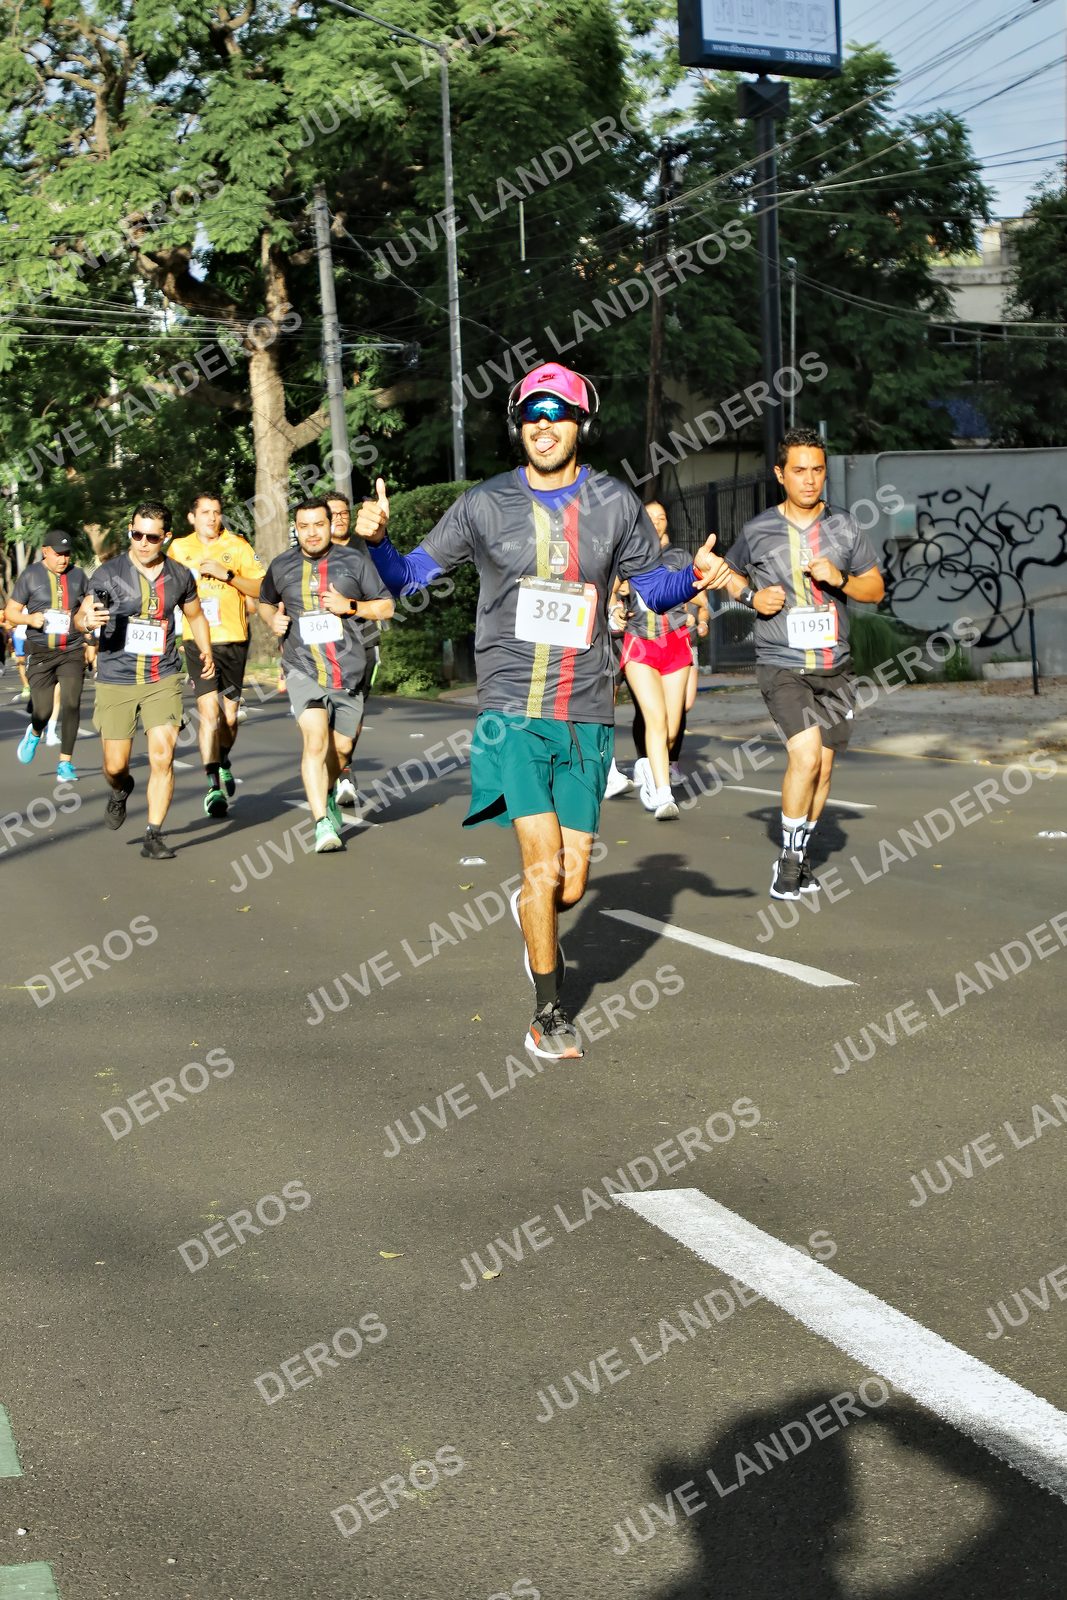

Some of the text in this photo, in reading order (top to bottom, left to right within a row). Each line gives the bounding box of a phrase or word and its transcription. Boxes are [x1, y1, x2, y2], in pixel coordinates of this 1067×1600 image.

[918, 483, 991, 512] TOY
[533, 599, 572, 623] 382
[309, 619, 329, 632] 364
[792, 618, 831, 633] 11951
[132, 629, 158, 642] 8241
